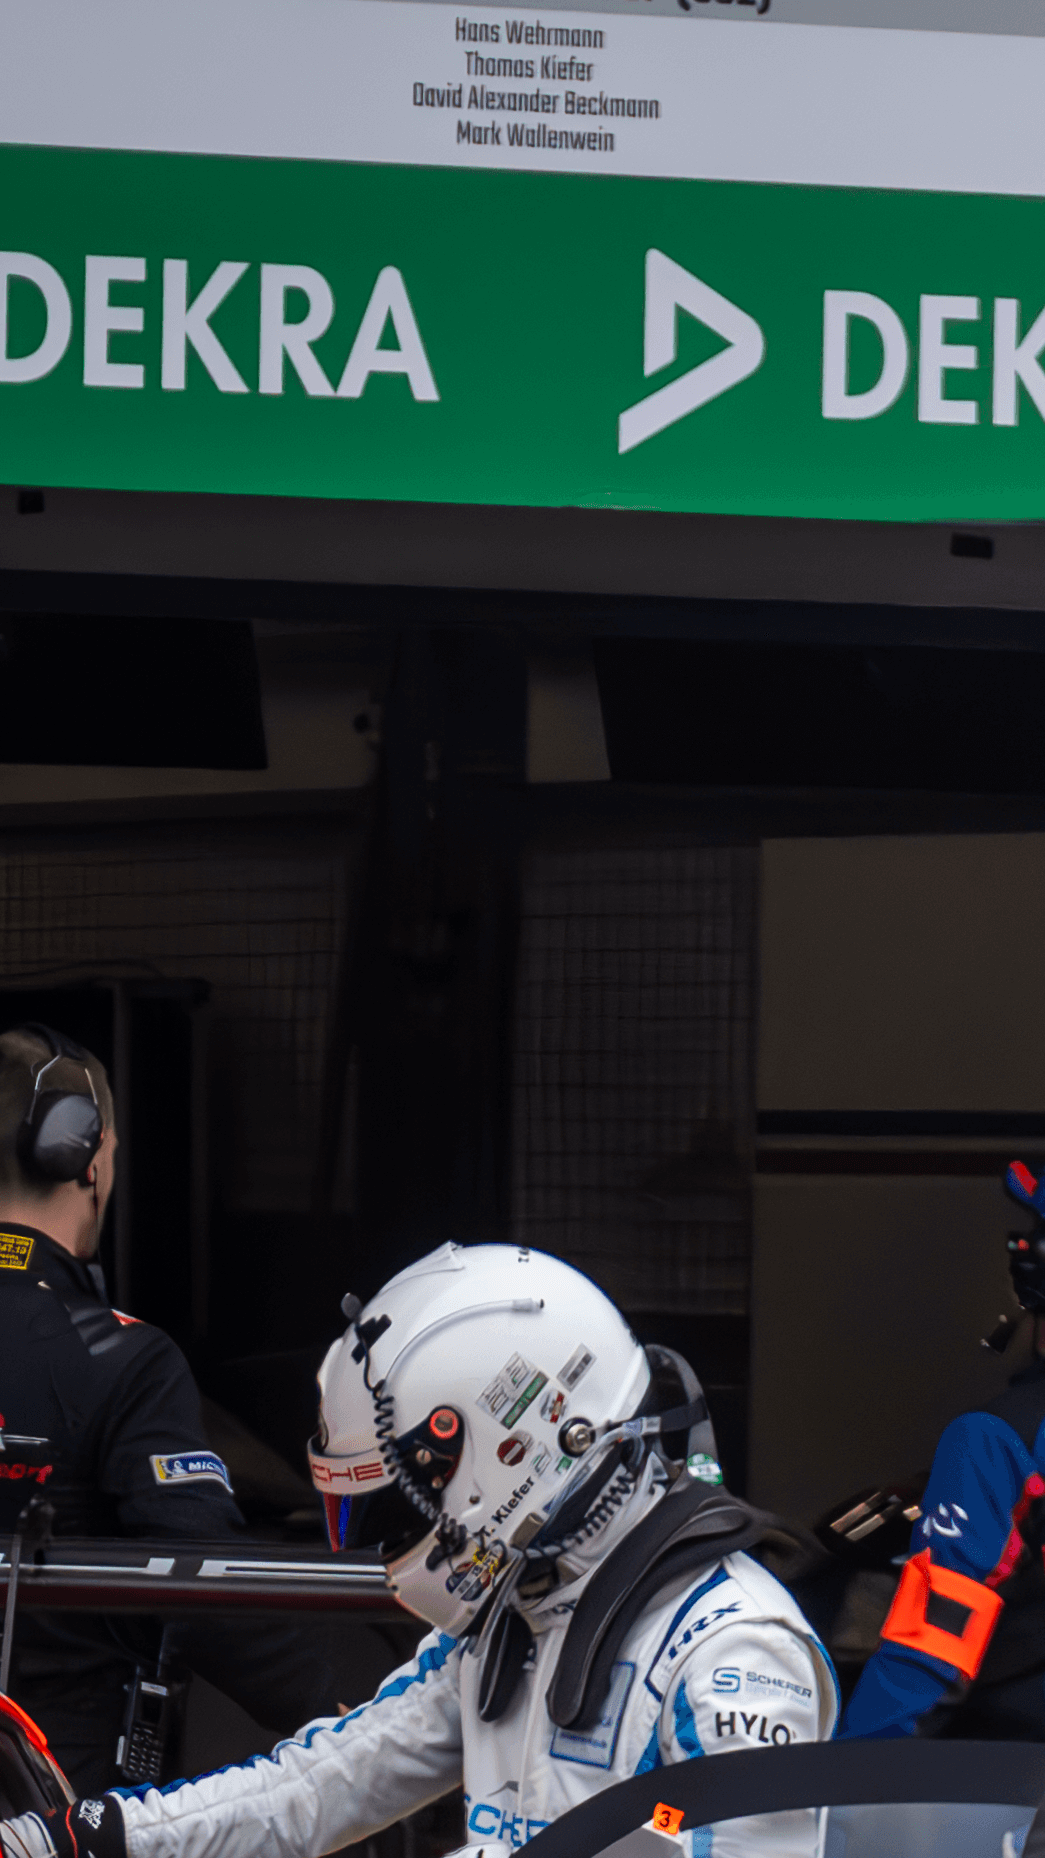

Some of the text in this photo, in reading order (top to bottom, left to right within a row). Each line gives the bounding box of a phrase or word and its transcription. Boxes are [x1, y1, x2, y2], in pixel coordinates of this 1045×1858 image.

[454, 17, 605, 49] Hans Wehrmann
[464, 51, 595, 82] Thomas Kiefer
[412, 82, 661, 120] David Alexander Beckmann
[456, 119, 615, 152] Mark Wallenwein
[491, 1475, 536, 1525] Kiefer
[714, 1710, 792, 1747] HYLO
